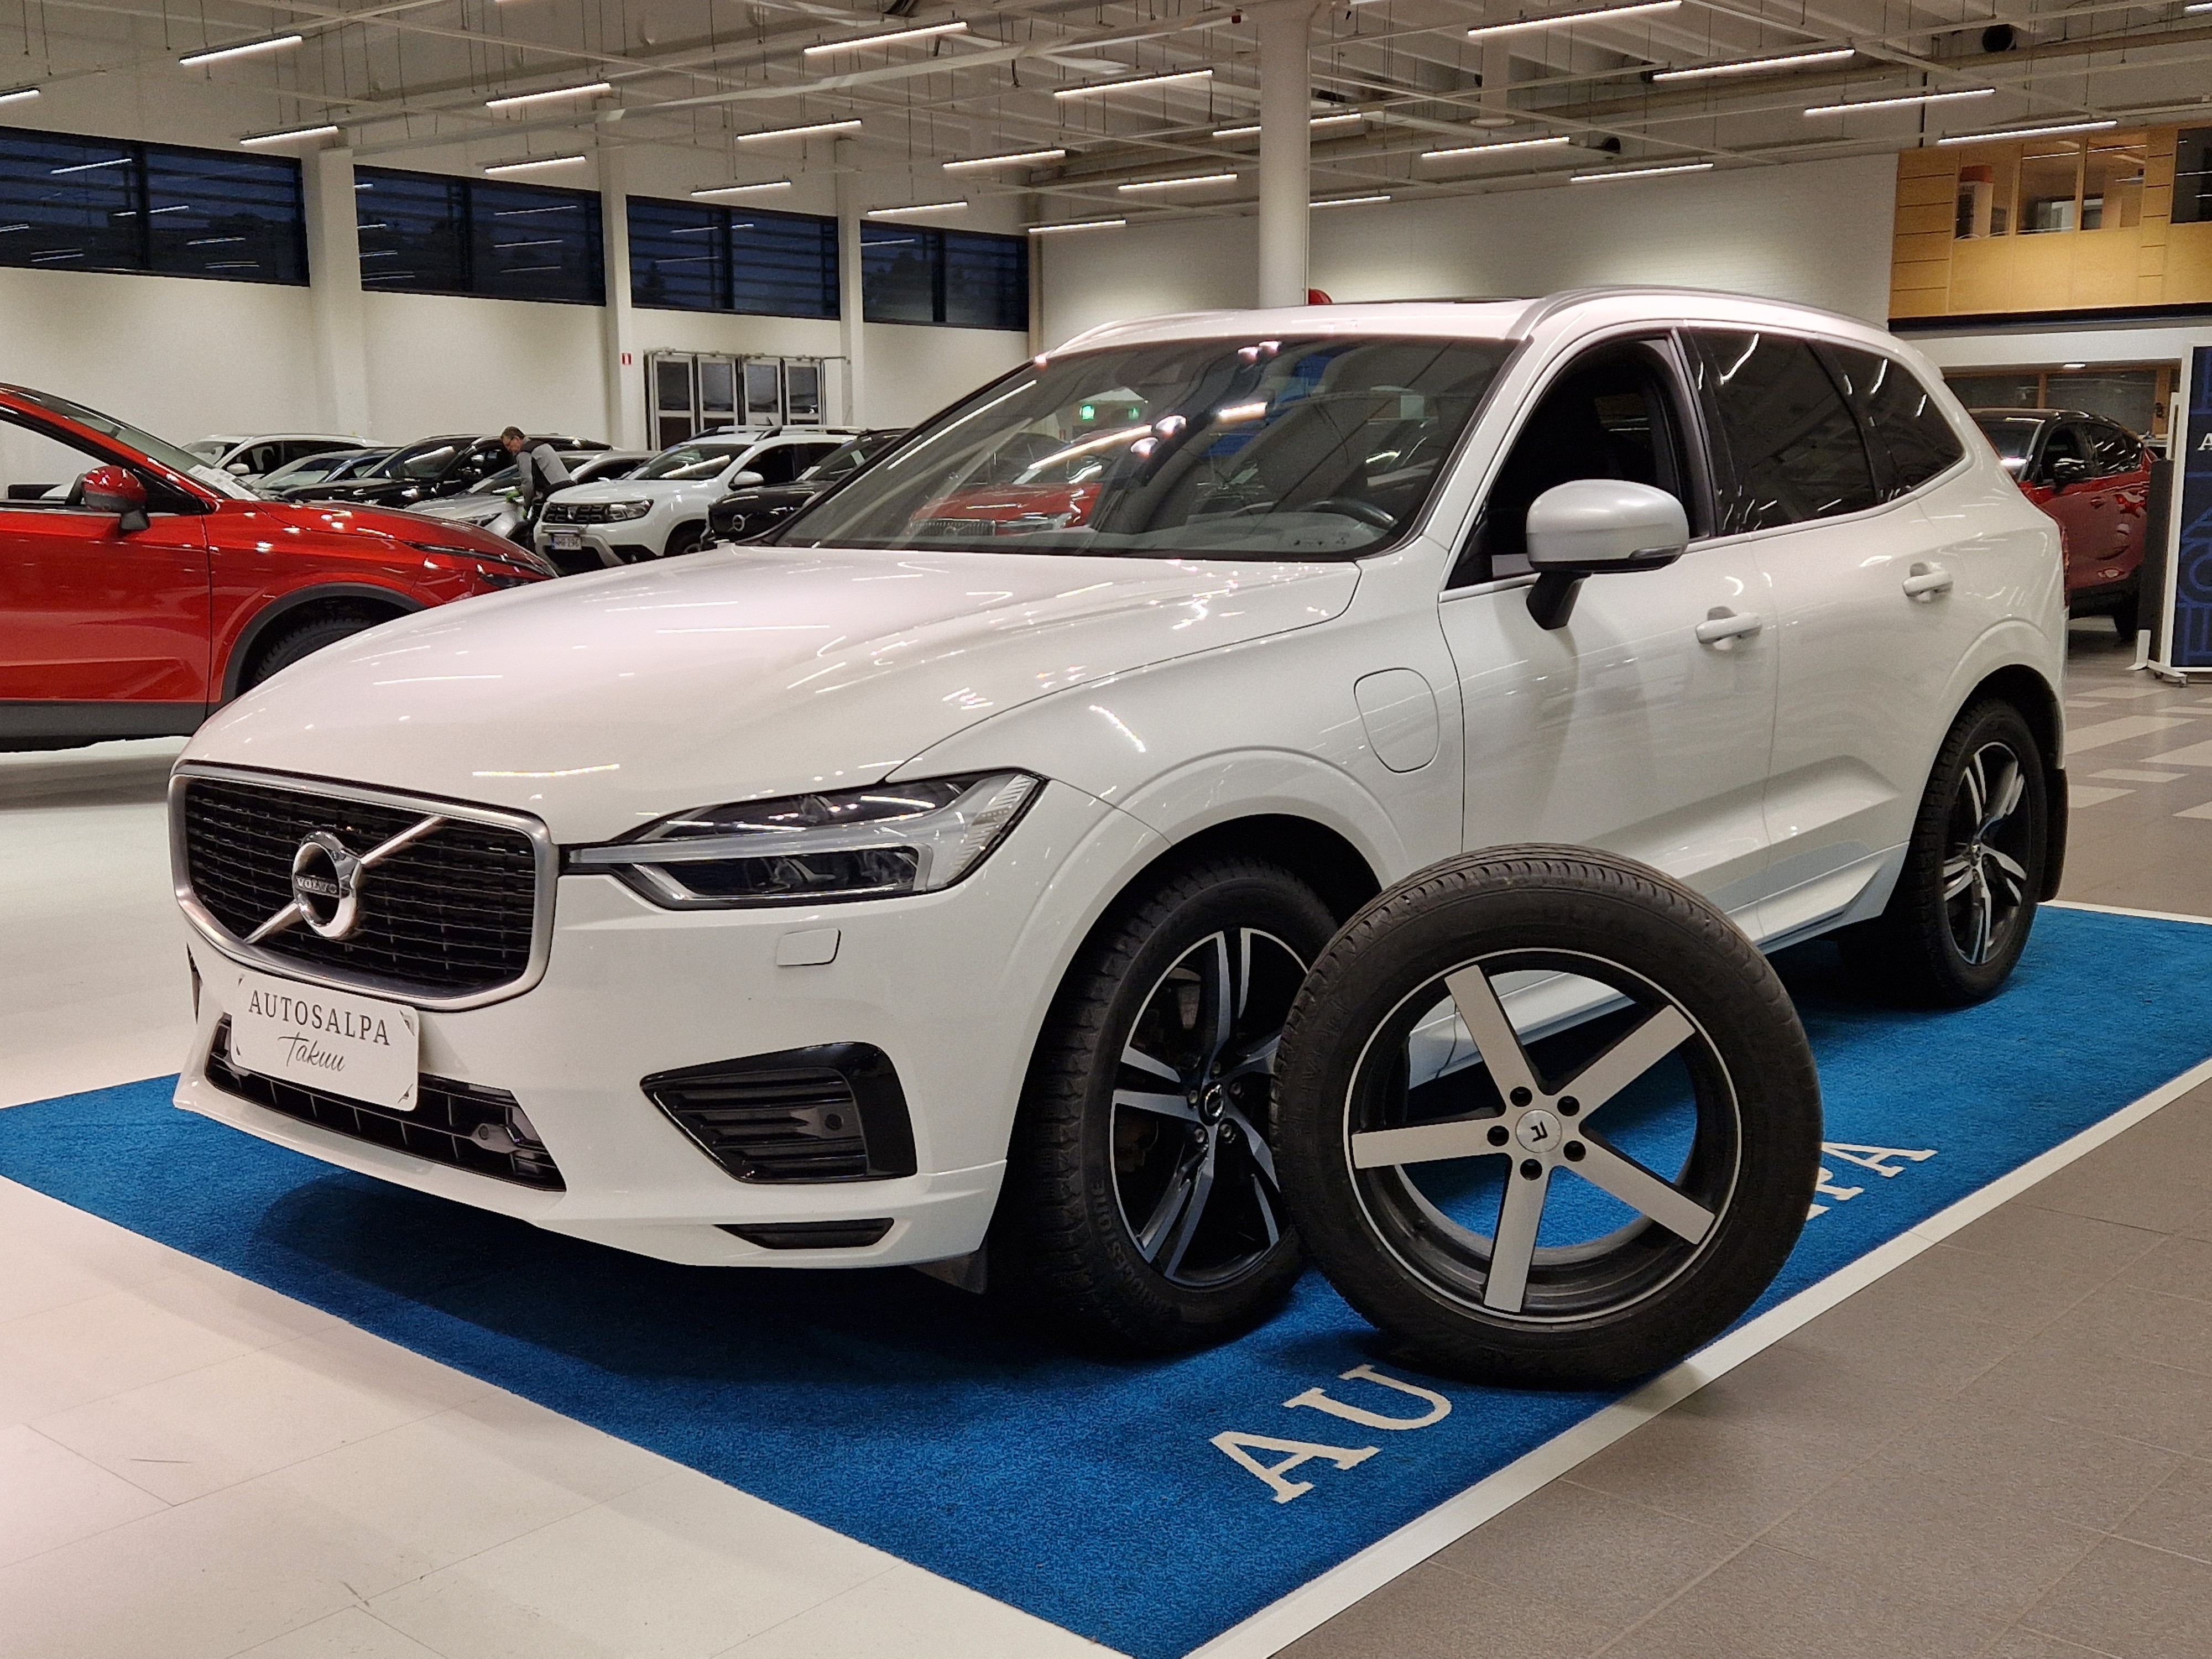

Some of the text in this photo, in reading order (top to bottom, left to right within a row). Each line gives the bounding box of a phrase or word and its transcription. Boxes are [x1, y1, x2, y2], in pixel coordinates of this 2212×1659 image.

[296, 877, 338, 894] VOLVO
[248, 989, 390, 1046] AUTOSALPA
[278, 1031, 345, 1072] Takuu
